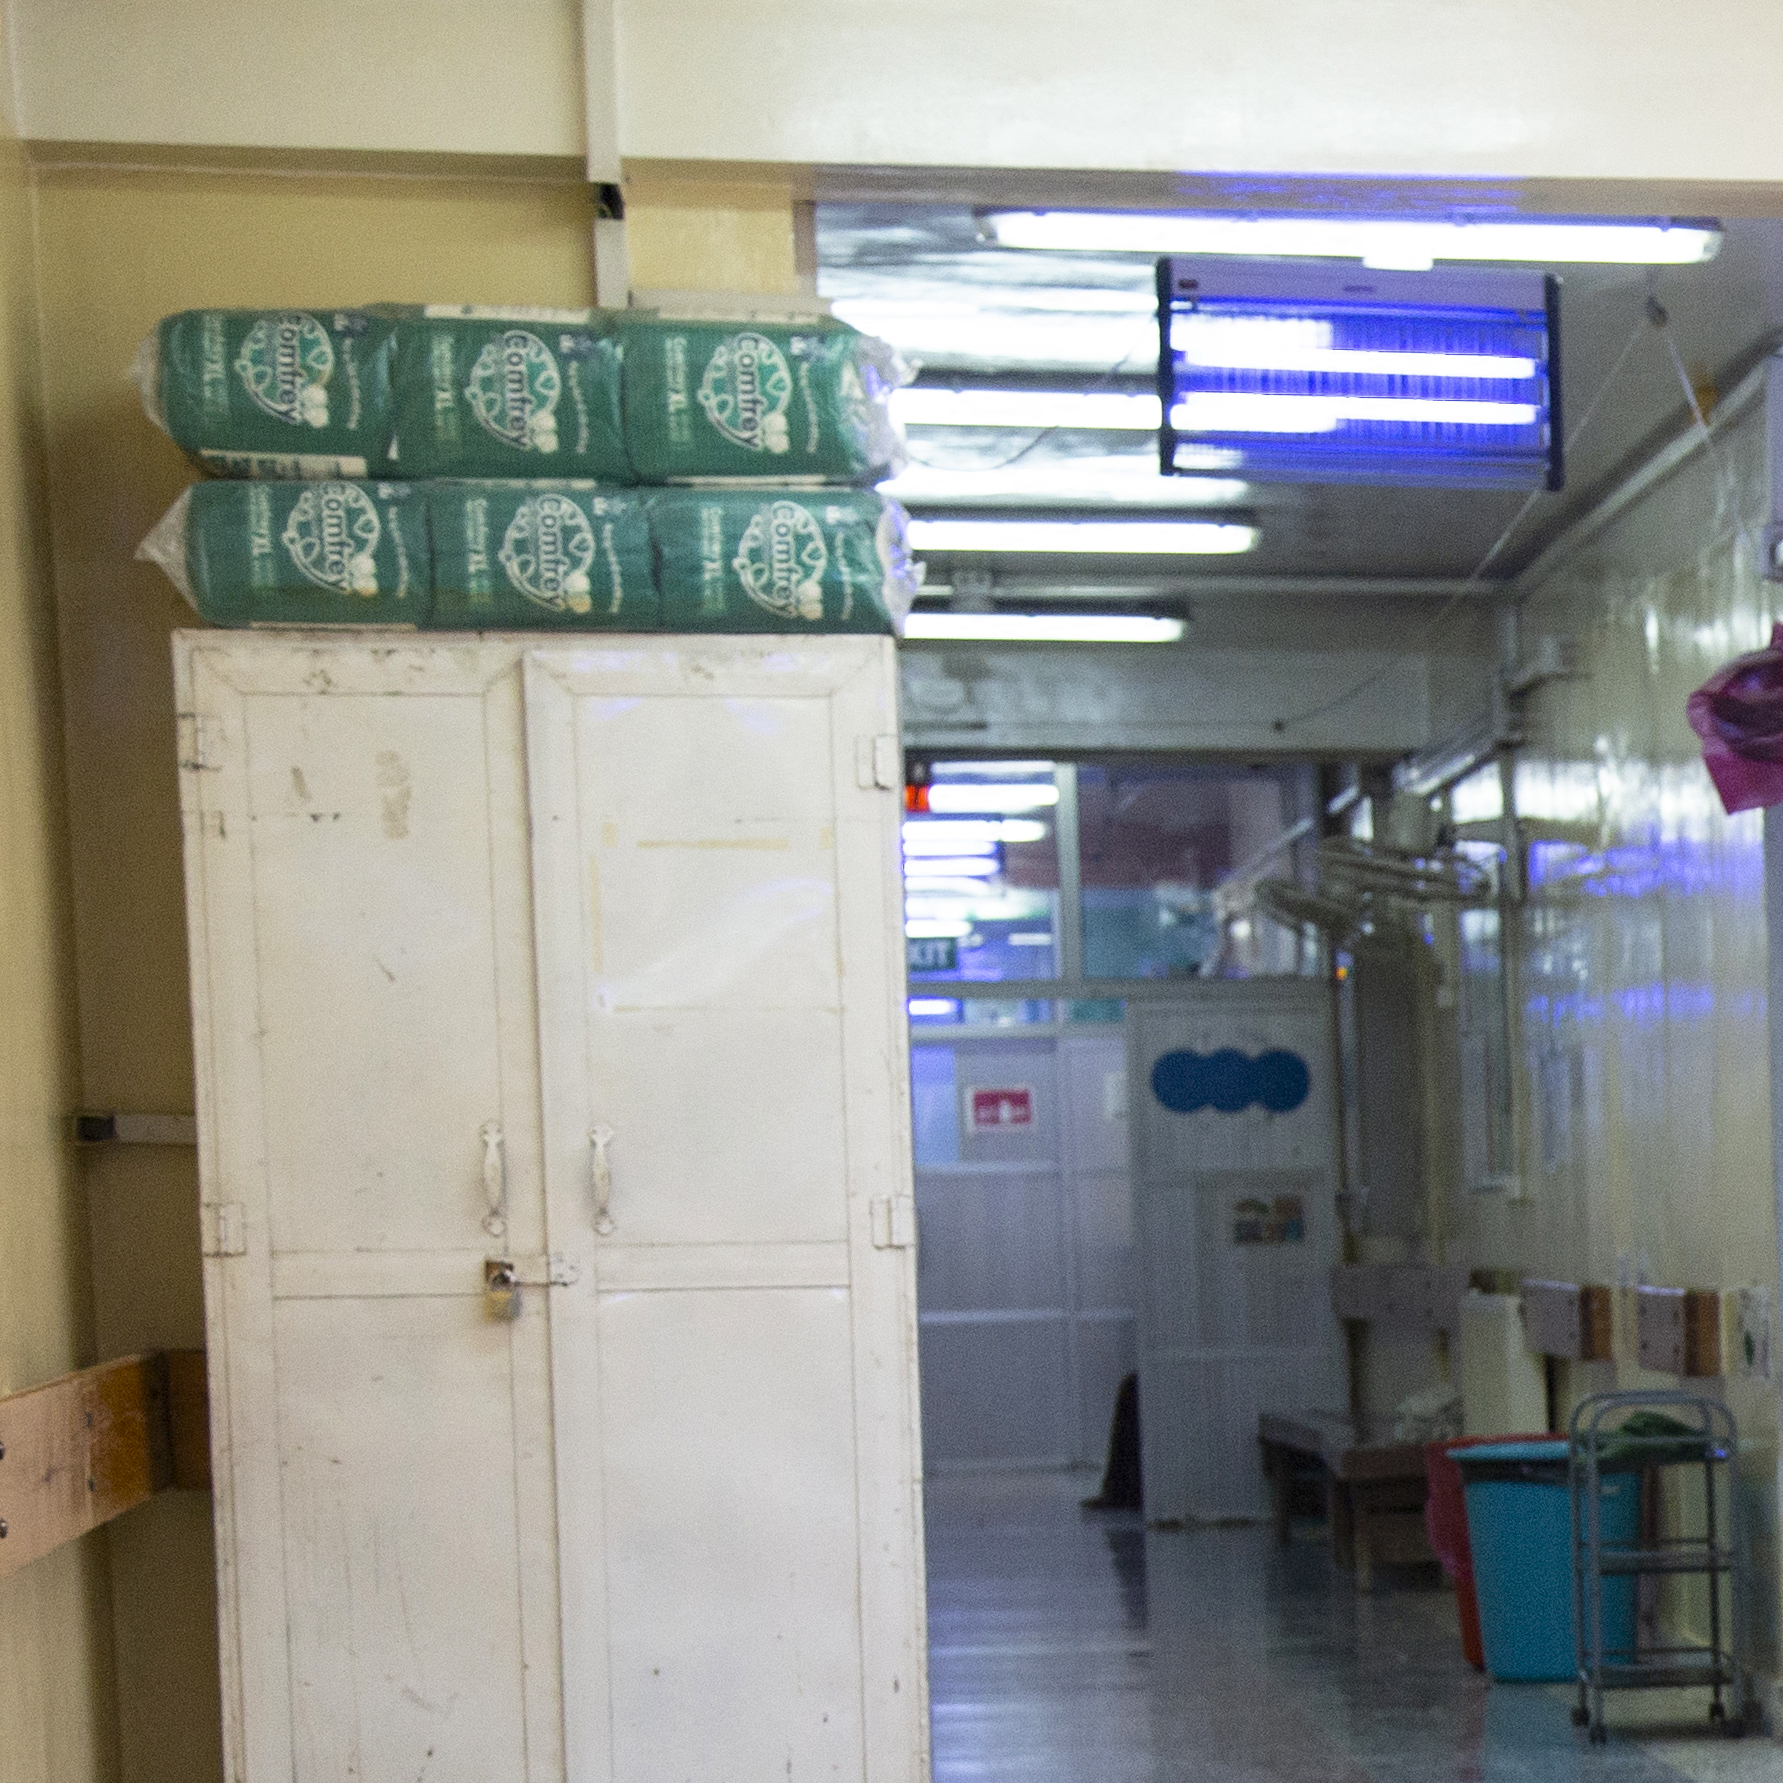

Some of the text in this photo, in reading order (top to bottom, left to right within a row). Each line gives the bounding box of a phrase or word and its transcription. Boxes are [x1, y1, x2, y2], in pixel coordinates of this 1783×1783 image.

[500, 335, 534, 448] Comfrey
[732, 335, 765, 449] Comfrey
[536, 500, 568, 609] Comfrey
[769, 505, 800, 616] Comfrey
